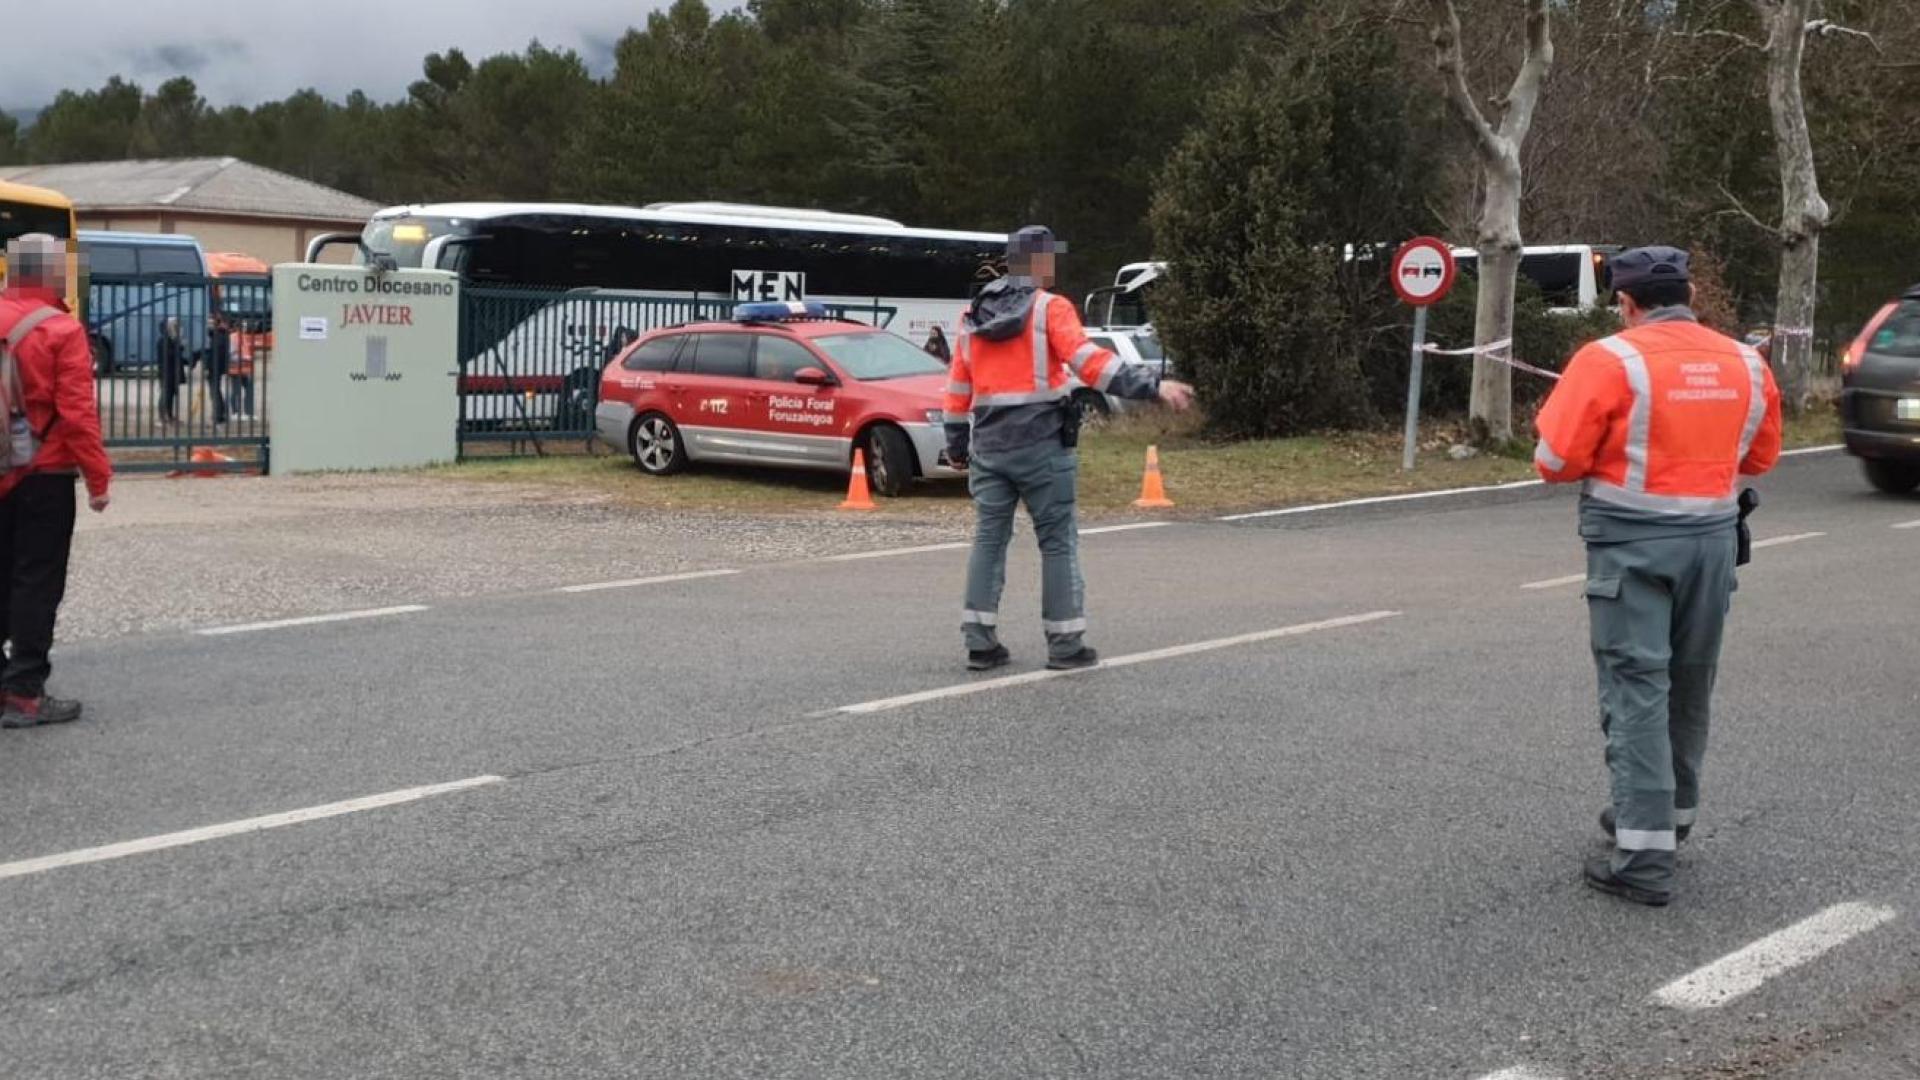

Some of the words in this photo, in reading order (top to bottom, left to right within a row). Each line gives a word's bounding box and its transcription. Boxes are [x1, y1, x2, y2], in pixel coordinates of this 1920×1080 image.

[298, 274, 358, 293] Centro
[364, 276, 453, 295] Diocesano
[734, 272, 802, 301] MEN
[341, 303, 413, 328] JAVIER
[807, 397, 834, 410] Foral
[769, 409, 833, 426] Foruzaingoa
